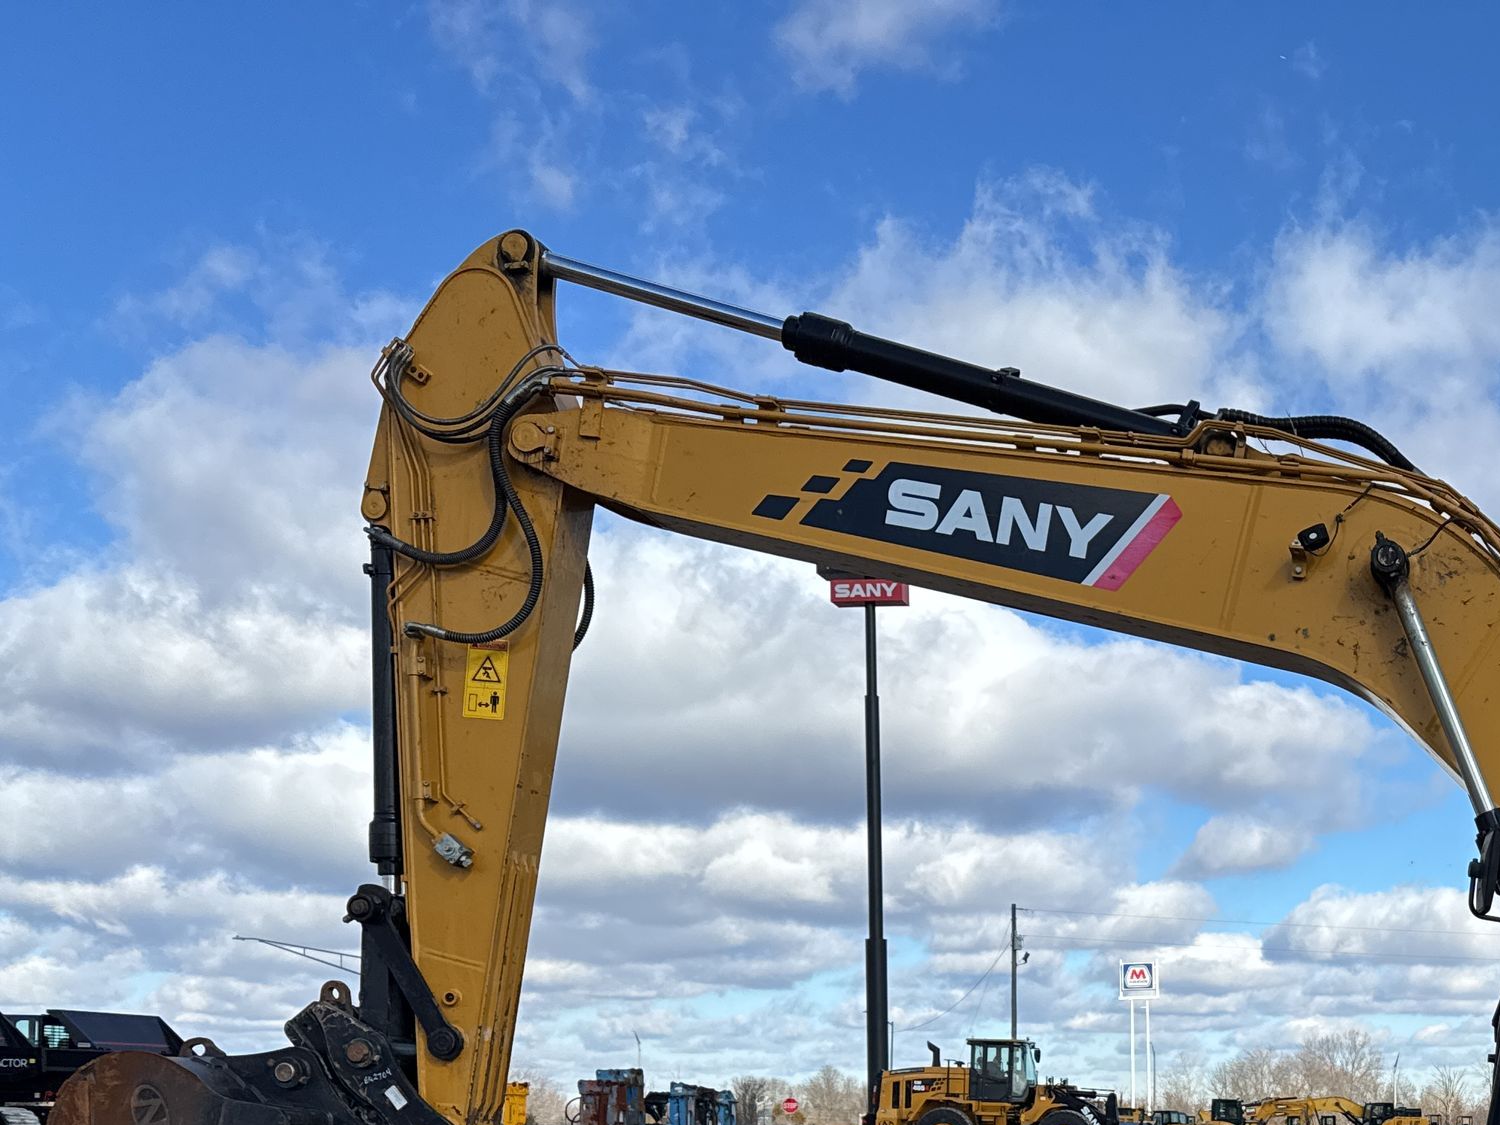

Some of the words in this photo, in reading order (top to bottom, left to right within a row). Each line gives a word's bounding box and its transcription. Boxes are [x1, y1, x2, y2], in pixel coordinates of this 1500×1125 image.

[885, 478, 1115, 559] SANY
[834, 582, 898, 598] SANY
[0, 1058, 28, 1068] CTOR
